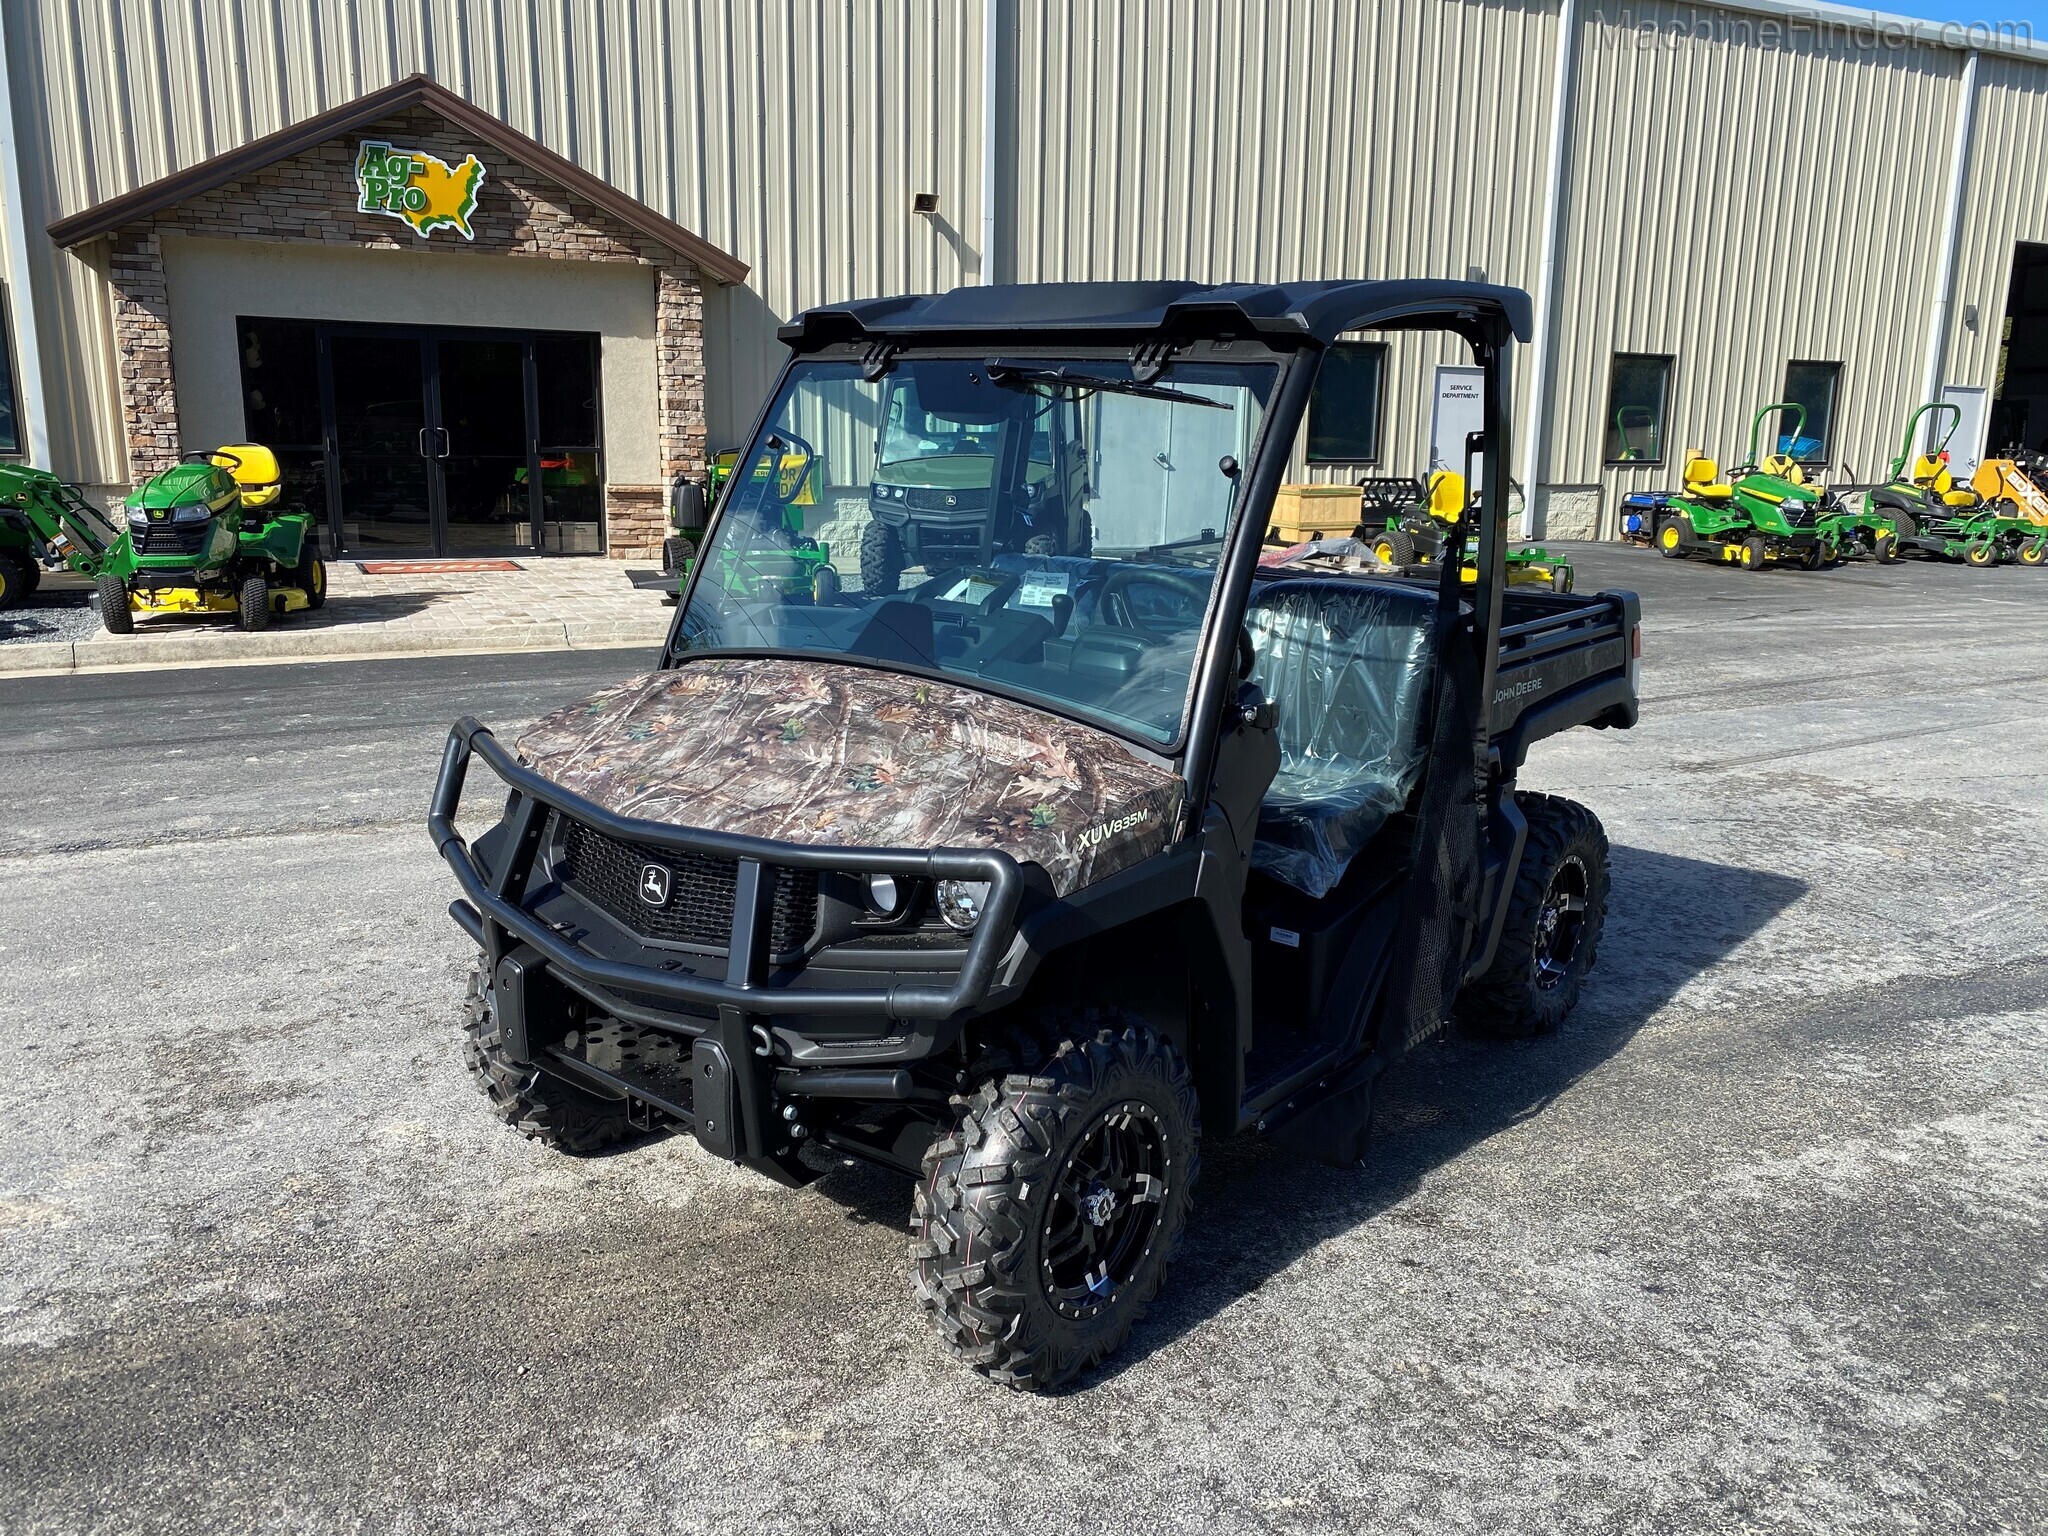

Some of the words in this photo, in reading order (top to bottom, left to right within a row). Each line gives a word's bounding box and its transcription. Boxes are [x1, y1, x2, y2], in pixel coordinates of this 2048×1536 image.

[361, 145, 424, 186] Ag-
[361, 177, 426, 211] Pro
[1493, 687, 1515, 704] JOHN
[1516, 678, 1543, 697] DEERE
[1078, 808, 1148, 852] XUV835M
